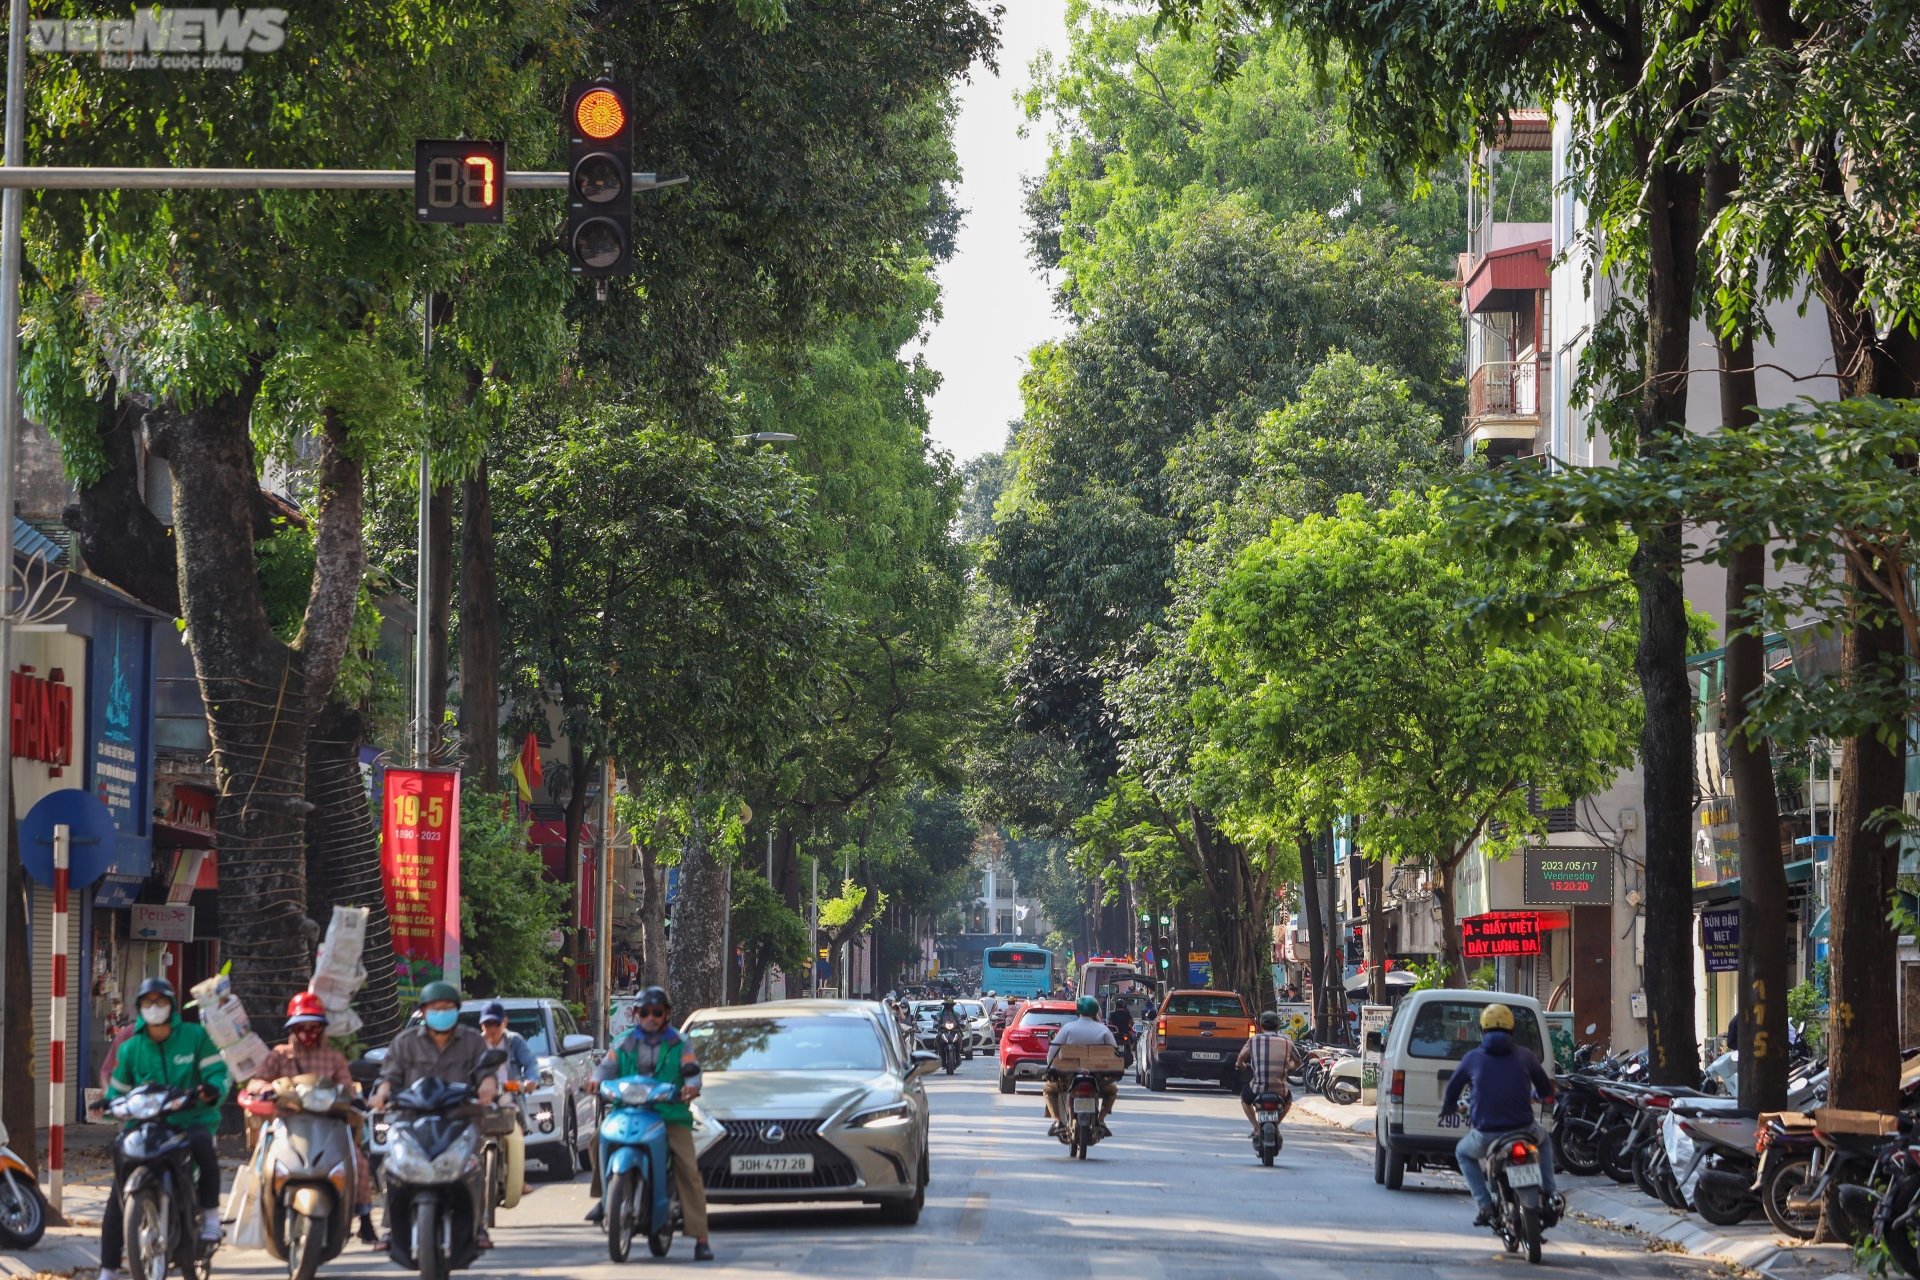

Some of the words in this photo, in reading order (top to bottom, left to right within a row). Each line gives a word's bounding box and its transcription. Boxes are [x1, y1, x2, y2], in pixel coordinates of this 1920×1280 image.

[393, 794, 444, 828] 19-5
[394, 829, 414, 839] 1890
[421, 831, 441, 840] 2023
[411, 854, 434, 866] MẠNH
[399, 866, 414, 877] HỌC
[415, 866, 429, 878] TẬP
[1543, 871, 1595, 882] Wednesday
[391, 876, 401, 887] VÀ
[401, 876, 417, 887] LÀM
[418, 879, 437, 889] THEO
[1550, 882, 1589, 891] 15:20:20
[396, 902, 411, 914] ĐẠO
[414, 914, 435, 926] CÁCH
[1704, 914, 1720, 928] BÚN
[1721, 913, 1738, 929] ĐẬU
[396, 926, 410, 937] CHÍ
[410, 927, 430, 937] MINH
[1508, 919, 1532, 935] VIỆT
[1521, 939, 1537, 952] DA
[737, 1158, 806, 1171] 30H-477.28
